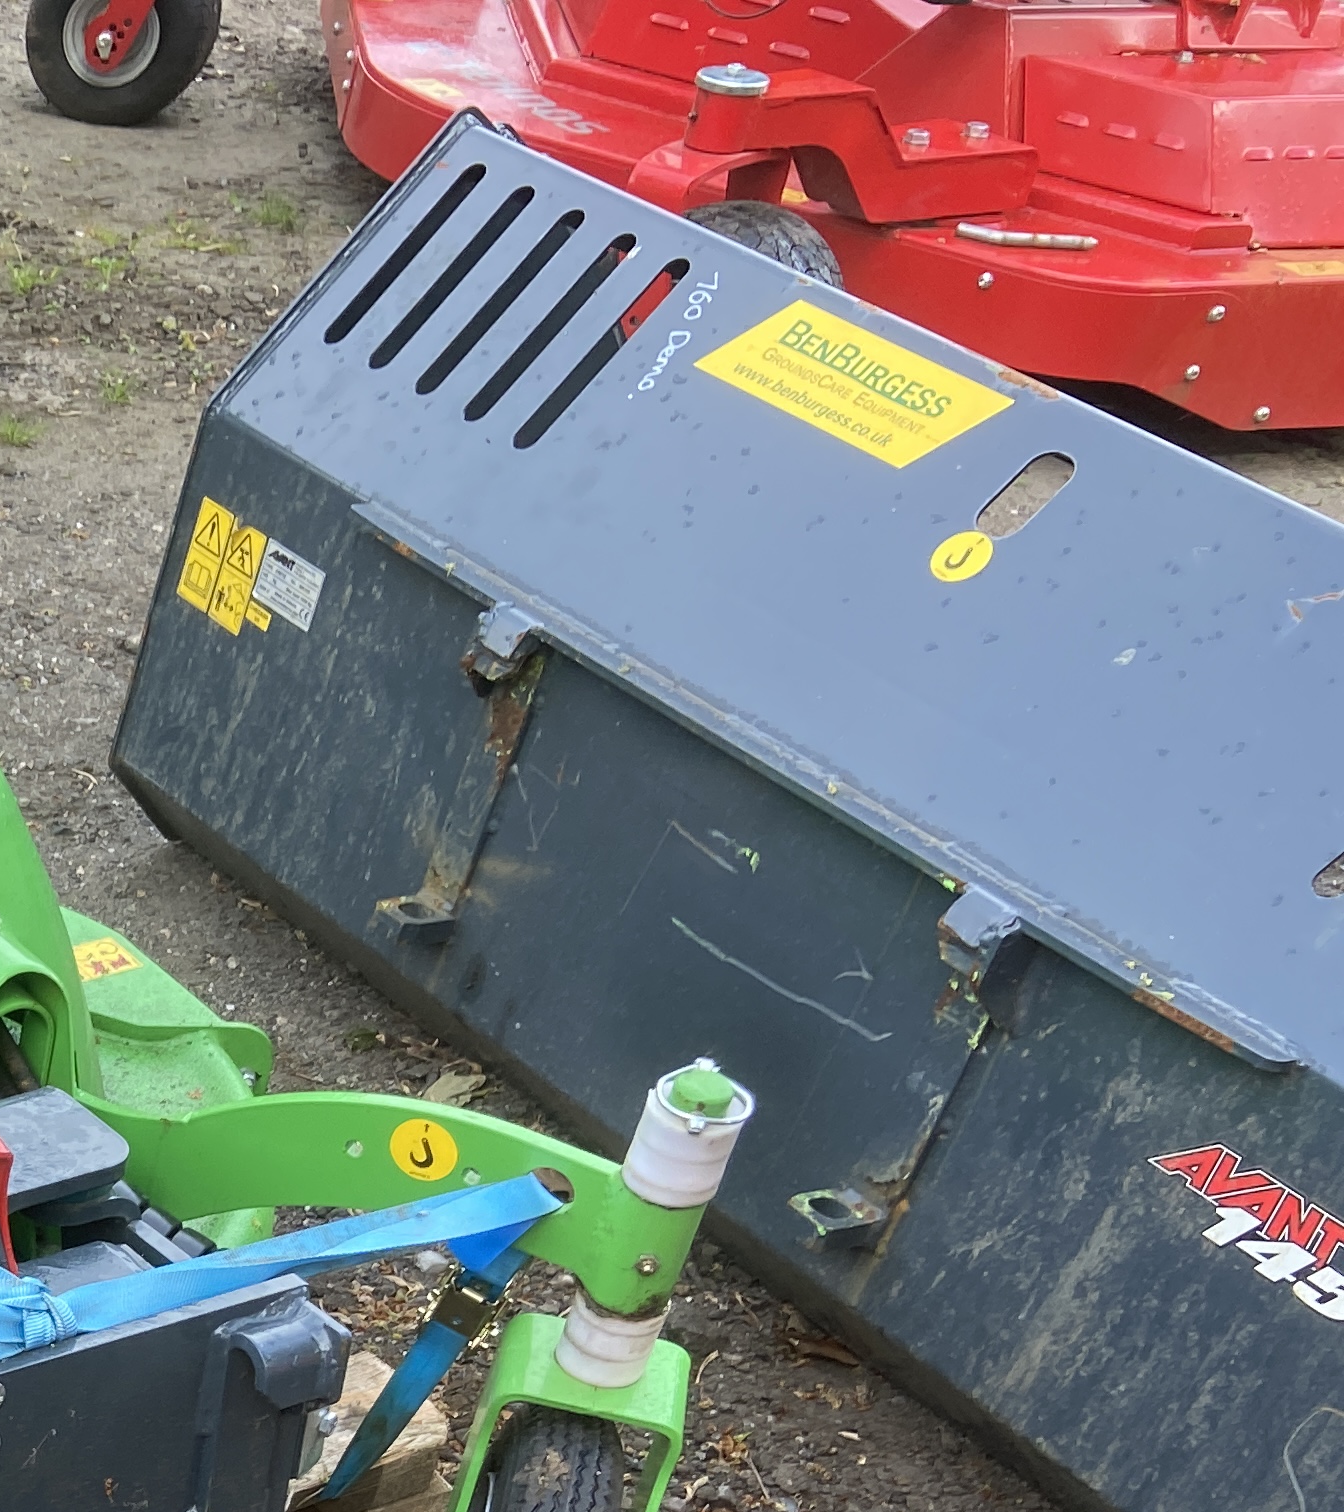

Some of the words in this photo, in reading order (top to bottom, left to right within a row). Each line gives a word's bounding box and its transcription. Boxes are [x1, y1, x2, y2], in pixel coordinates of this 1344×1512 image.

[733, 362, 894, 448] www.benburgess.co.uk
[852, 391, 926, 436] EQUIPMENT
[1147, 1143, 1344, 1270] AVANT
